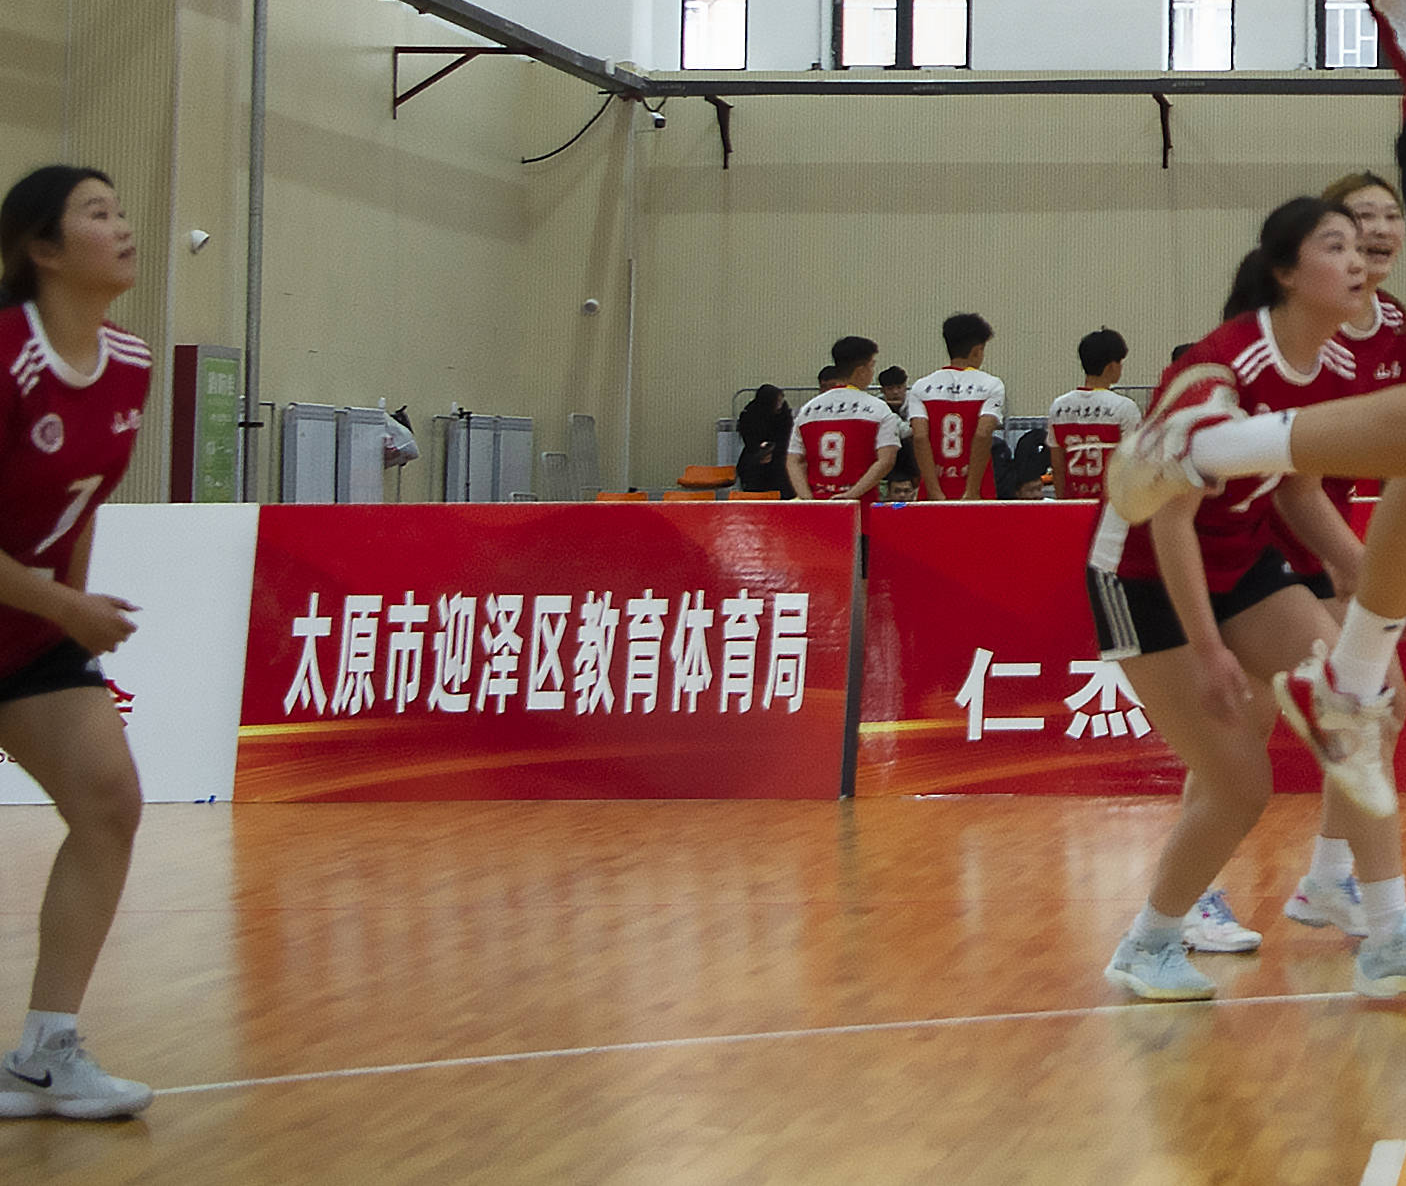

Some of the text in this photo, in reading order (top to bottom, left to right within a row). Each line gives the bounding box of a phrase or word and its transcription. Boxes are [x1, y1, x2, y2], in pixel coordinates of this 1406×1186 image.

[818, 430, 846, 477] 9
[942, 413, 964, 458] 8
[283, 588, 810, 718] 太原市迎泽区教育体育局
[955, 647, 1152, 742] 仁杰
